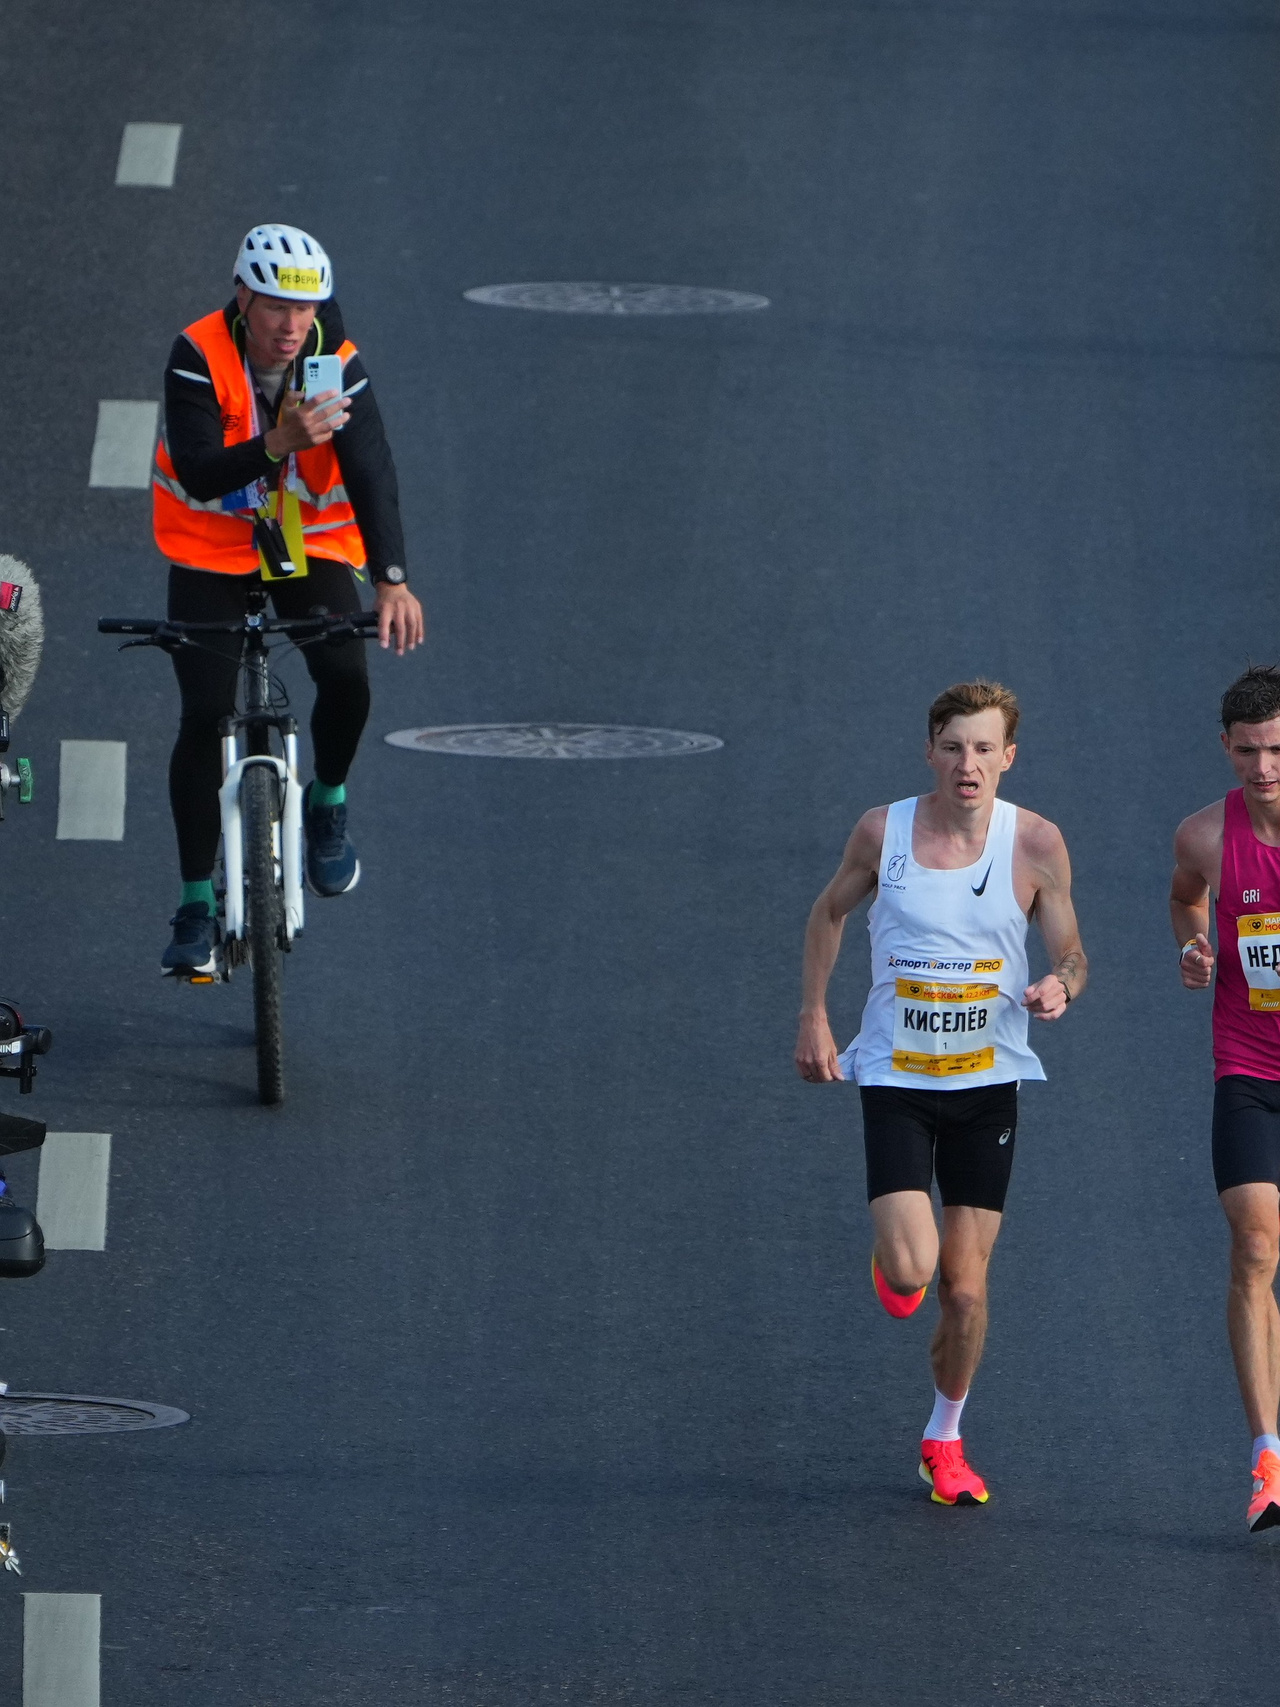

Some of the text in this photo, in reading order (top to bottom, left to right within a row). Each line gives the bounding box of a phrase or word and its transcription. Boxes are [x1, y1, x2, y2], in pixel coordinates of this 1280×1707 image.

[281, 274, 318, 285] РЕФЕРИ
[974, 961, 1000, 971] PRO
[923, 991, 958, 1000] МОСКВА
[903, 1006, 988, 1033] КИСЕЛЁВ
[942, 1042, 948, 1050] 1
